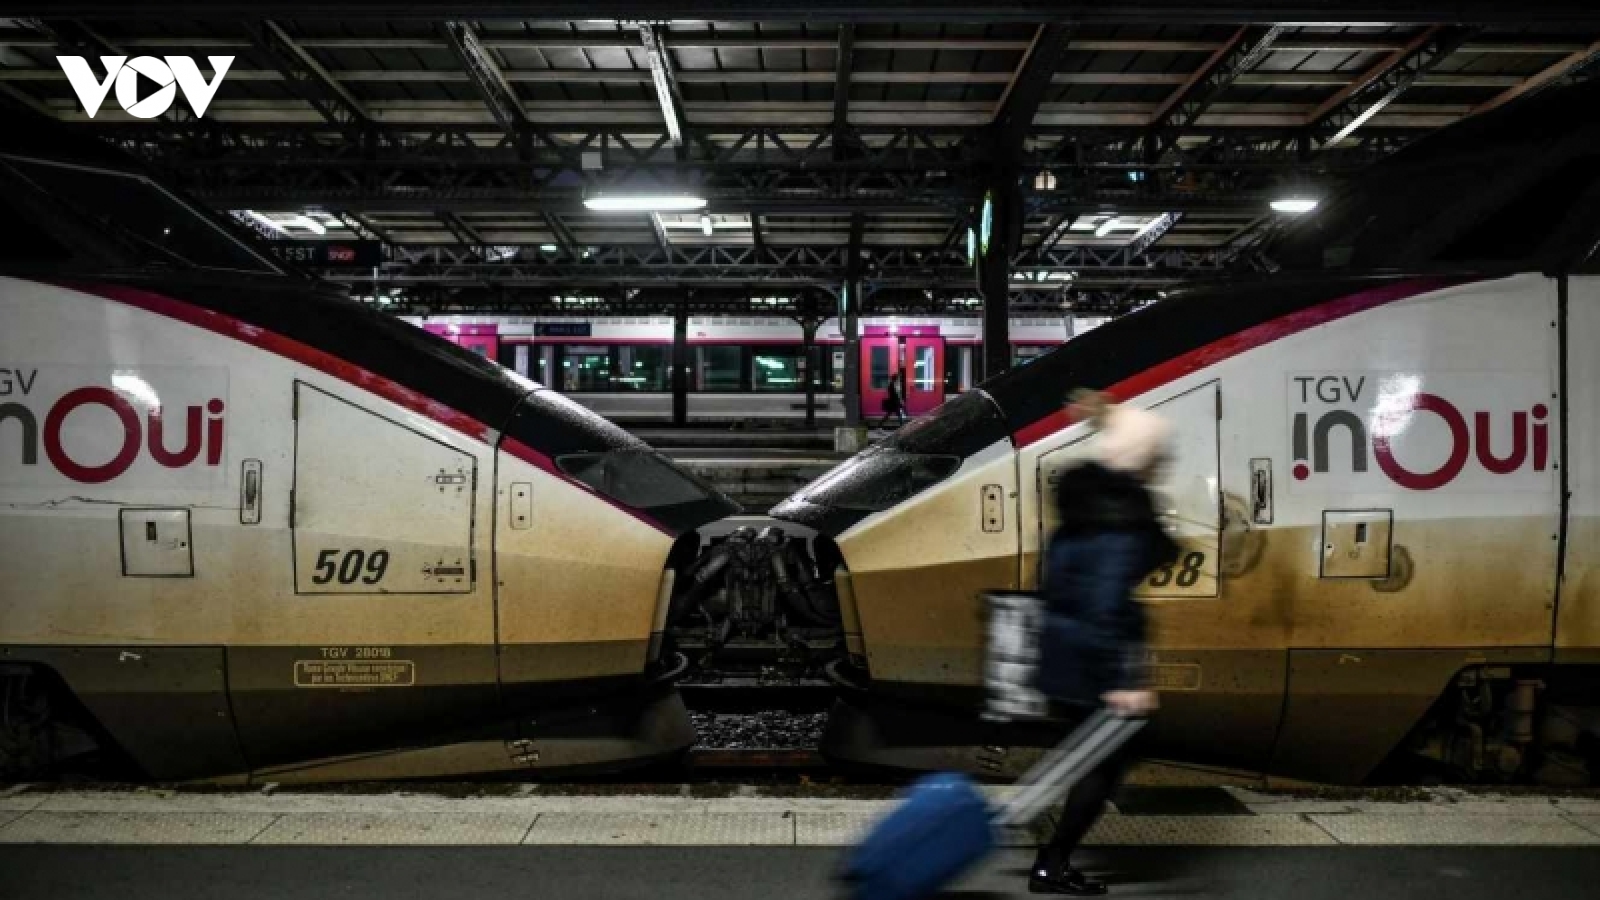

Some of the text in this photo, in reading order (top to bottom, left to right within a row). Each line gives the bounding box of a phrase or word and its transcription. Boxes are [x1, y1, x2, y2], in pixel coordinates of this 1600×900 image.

[1293, 375, 1365, 403] TGV
[312, 549, 390, 585] 509
[319, 647, 349, 659] TGV
